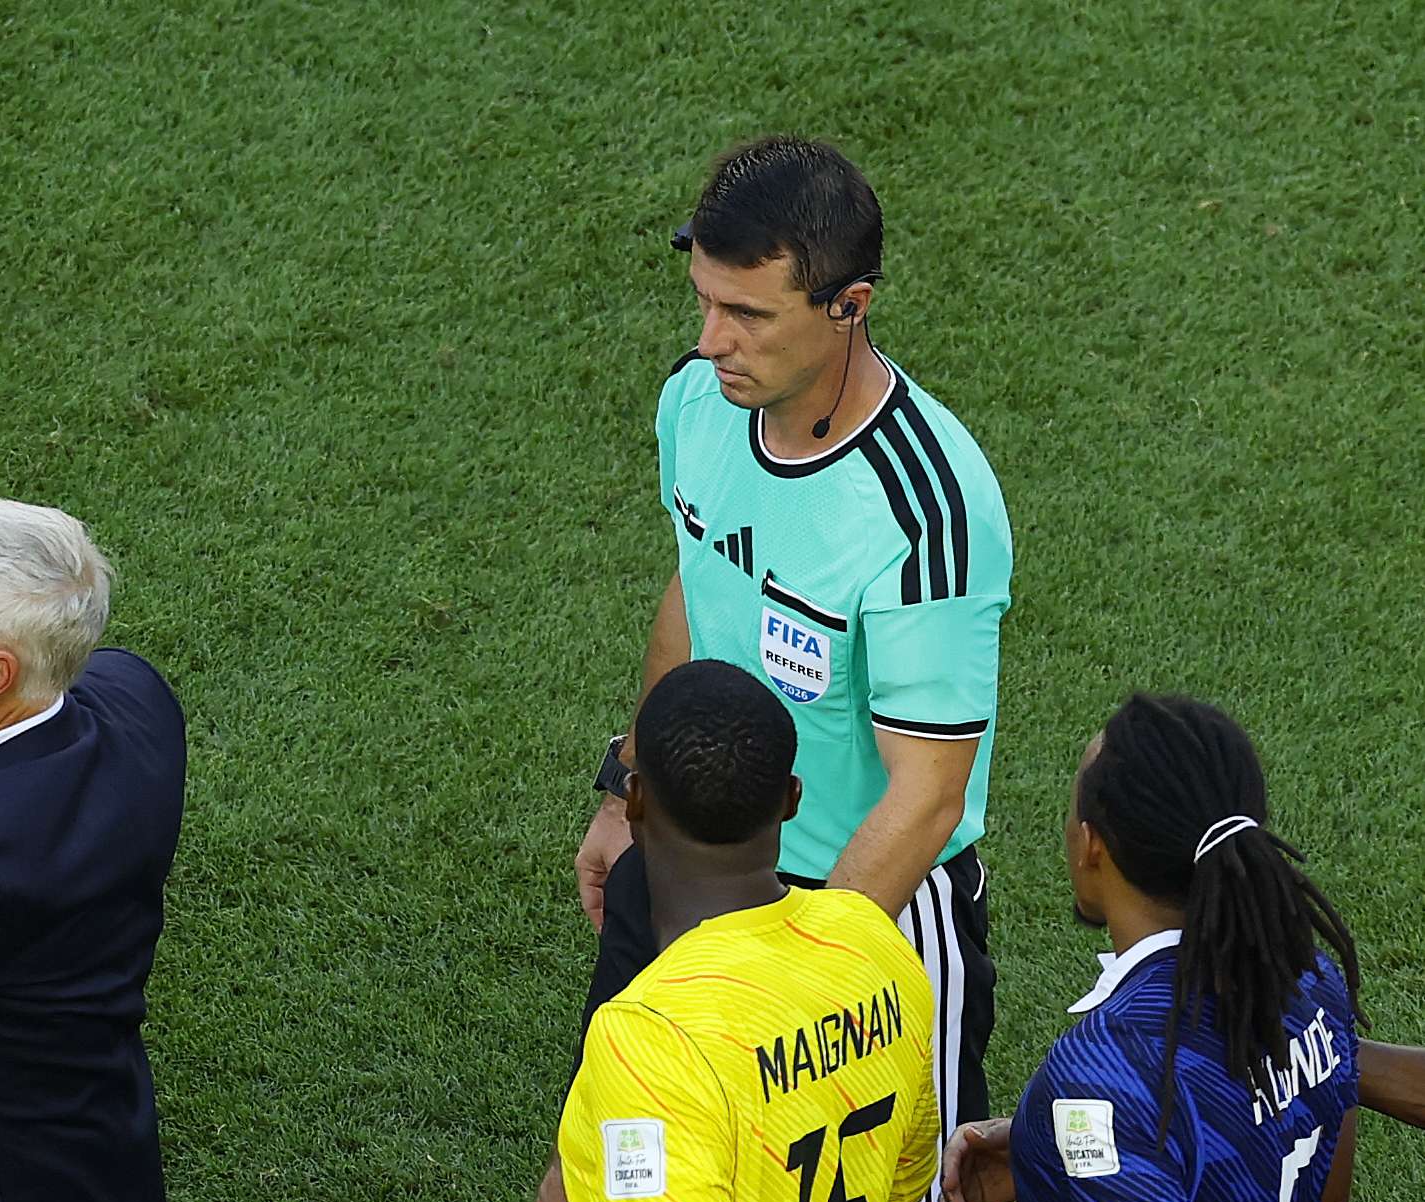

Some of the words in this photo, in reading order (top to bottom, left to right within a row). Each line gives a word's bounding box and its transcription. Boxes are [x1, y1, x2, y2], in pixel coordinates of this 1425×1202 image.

[767, 616, 822, 659] FIFA
[766, 650, 823, 681] REFEREE
[782, 683, 808, 700] 2026
[755, 980, 902, 1104] MAIGNAN
[1065, 1149, 1104, 1161] EDUCATION
[615, 1168, 653, 1181] EDUCATION
